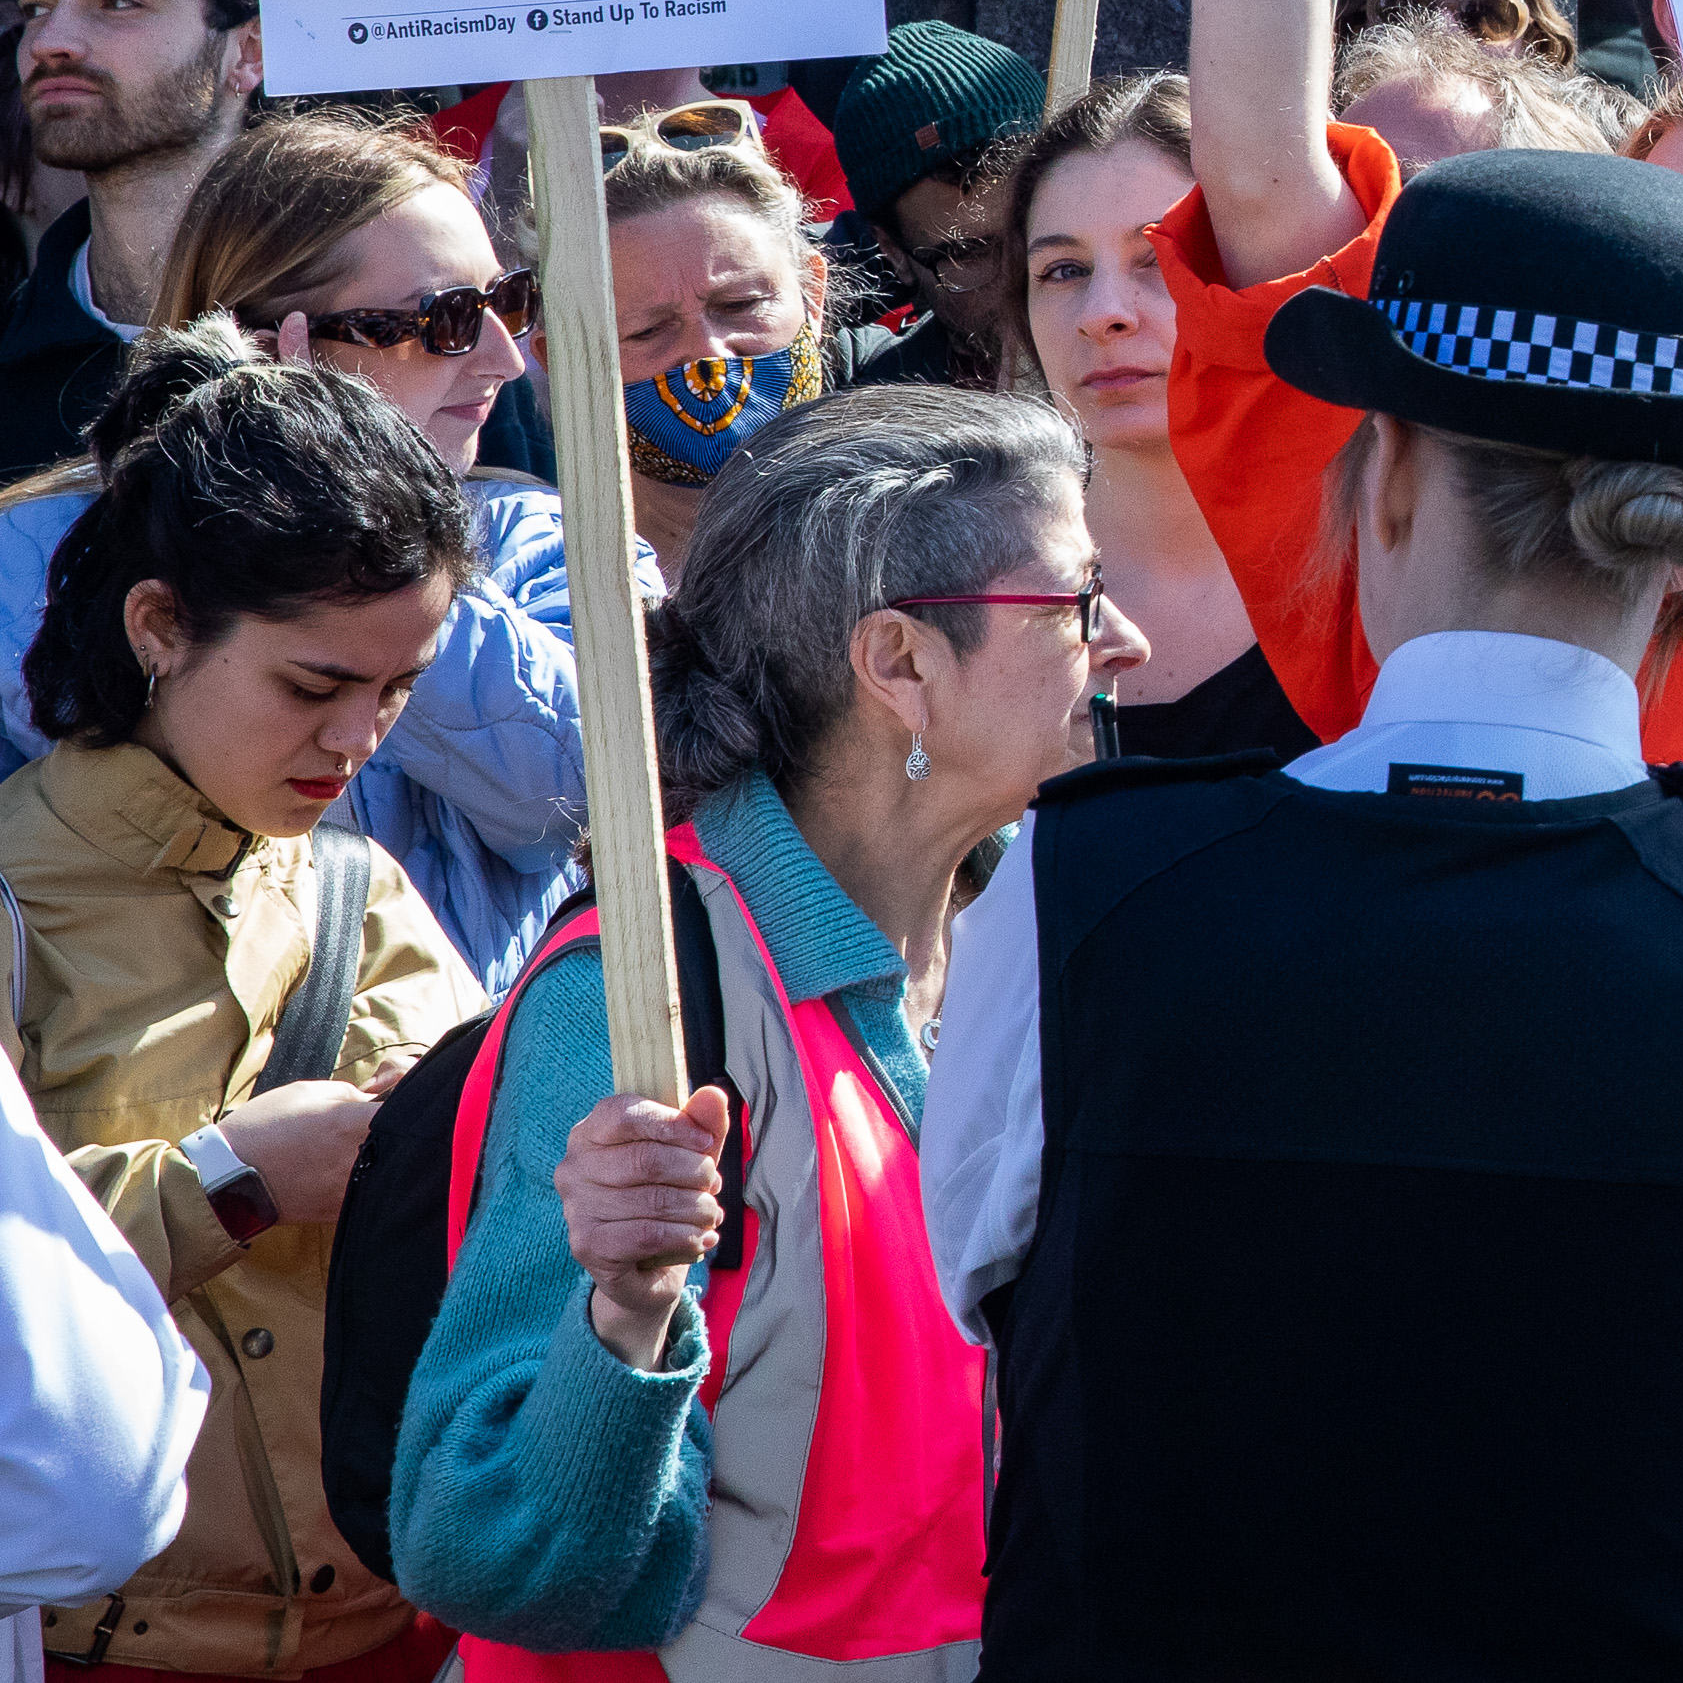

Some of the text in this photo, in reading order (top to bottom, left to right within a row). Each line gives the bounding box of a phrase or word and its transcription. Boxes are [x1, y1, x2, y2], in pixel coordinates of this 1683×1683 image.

[372, 14, 516, 40] @AntiRacismDay
[553, 6, 603, 26] Stand
[610, 4, 634, 25] Up
[640, 2, 659, 19] To
